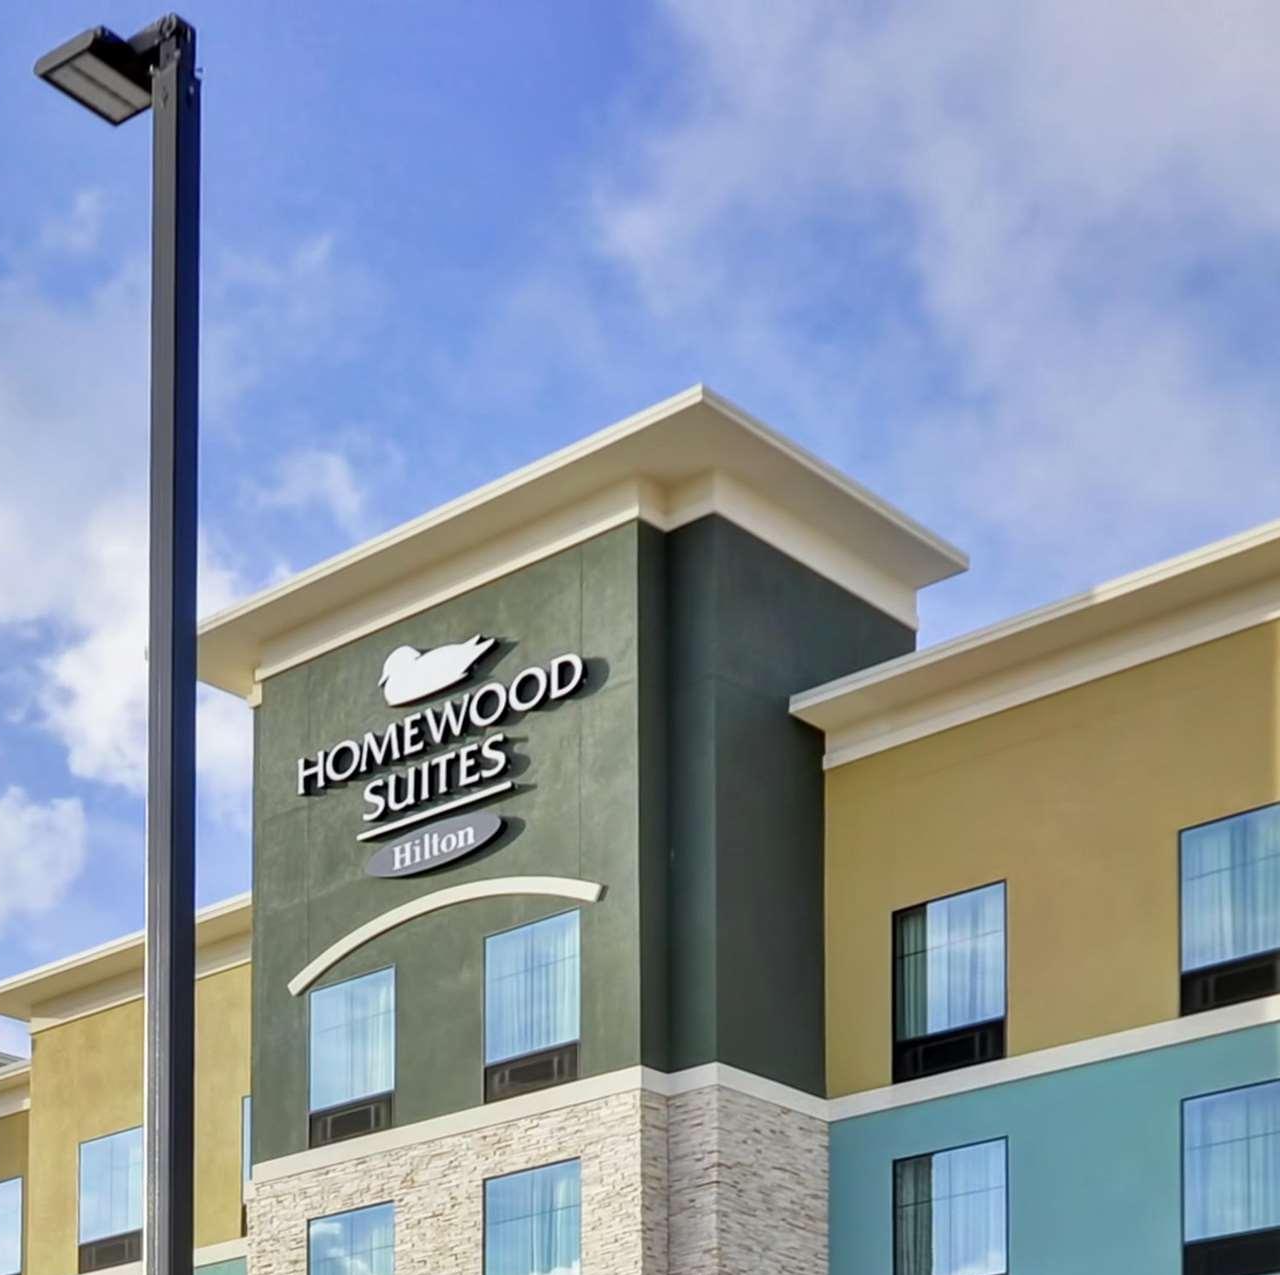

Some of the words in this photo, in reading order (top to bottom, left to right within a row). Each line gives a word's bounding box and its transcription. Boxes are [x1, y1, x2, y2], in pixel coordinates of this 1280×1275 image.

[297, 653, 584, 796] HOMEWOOD
[363, 733, 507, 821] SUITES
[391, 825, 475, 870] Hilton
